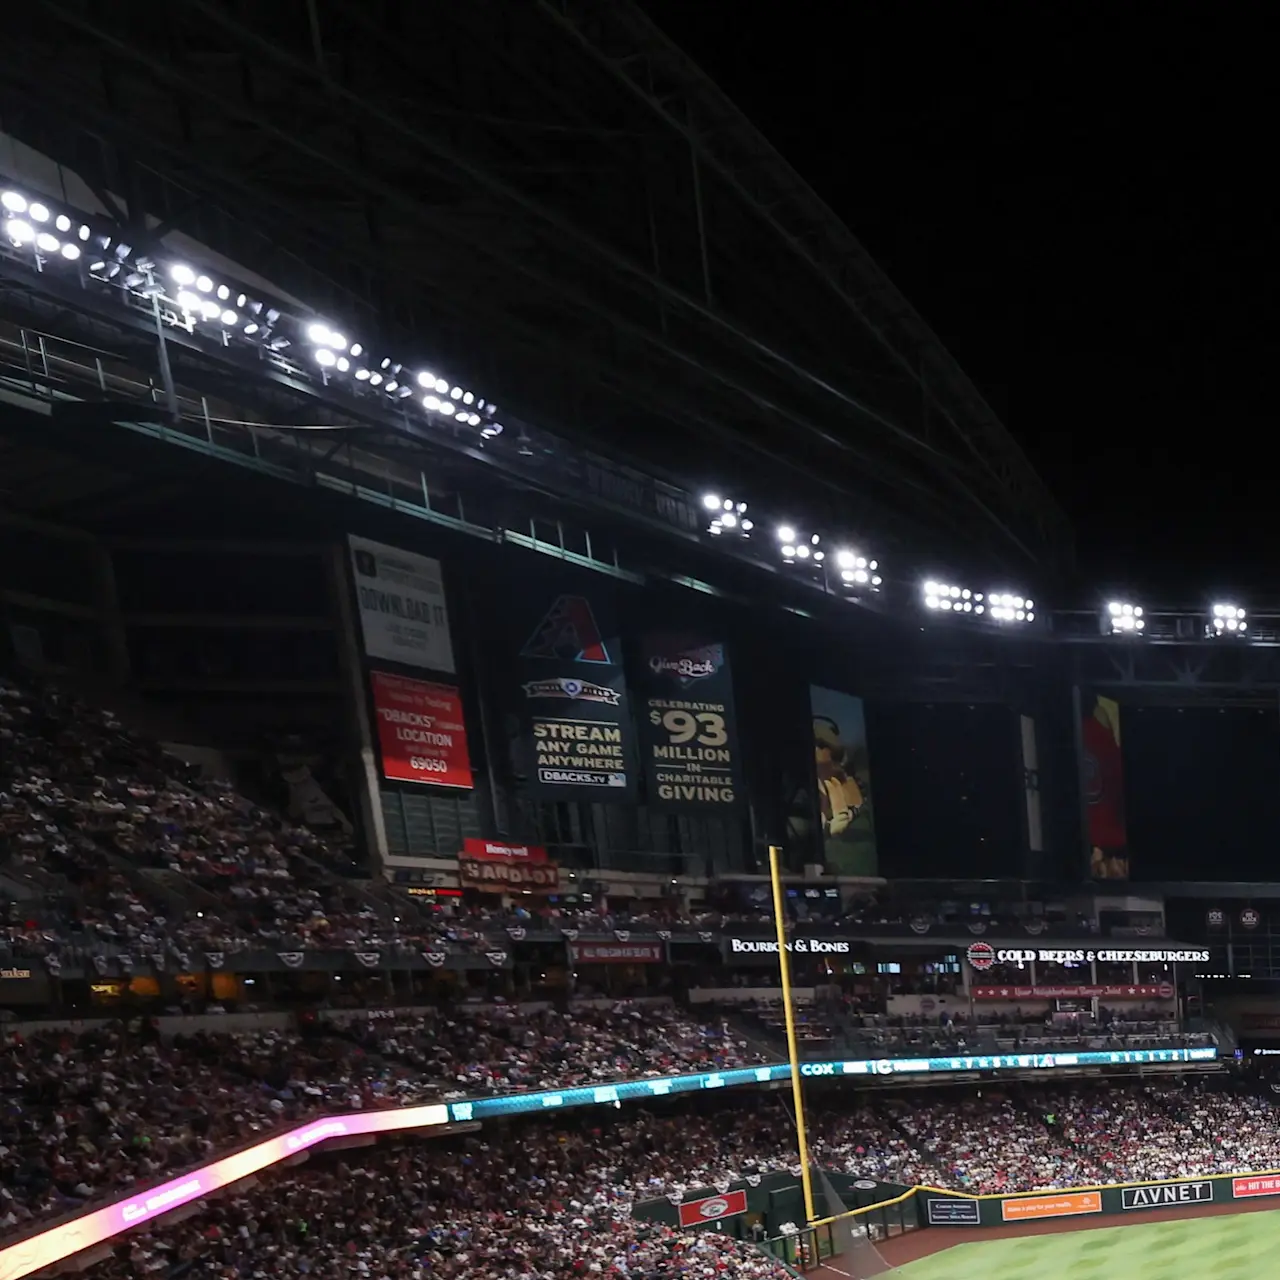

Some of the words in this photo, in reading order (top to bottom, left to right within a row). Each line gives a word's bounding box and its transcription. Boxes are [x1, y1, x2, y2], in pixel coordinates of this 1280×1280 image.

[648, 700, 725, 712] CELEBRATING
[533, 724, 621, 742] STREAM
[650, 710, 728, 746] $93
[396, 727, 453, 748] LOCATION
[536, 741, 571, 753] ANY
[576, 743, 623, 757] GAME
[653, 745, 731, 762] MILLION
[537, 755, 624, 770] ANYWHERE
[686, 763, 701, 773] IN
[656, 773, 734, 786] CHARITABLE
[658, 785, 735, 802] GIVING
[486, 844, 529, 856] Honeywell
[464, 861, 556, 883] SANDLOT
[795, 939, 808, 952] &
[810, 939, 850, 952] BONES
[997, 950, 1036, 962] COLD
[1038, 950, 1084, 962] BEERS
[1086, 951, 1096, 961] &
[1097, 950, 1210, 962] CHEESEBURGERS
[801, 1063, 834, 1075] COX
[1248, 1181, 1260, 1190] HIT
[1260, 1180, 1274, 1189] THE
[1133, 1184, 1204, 1206] AVNET
